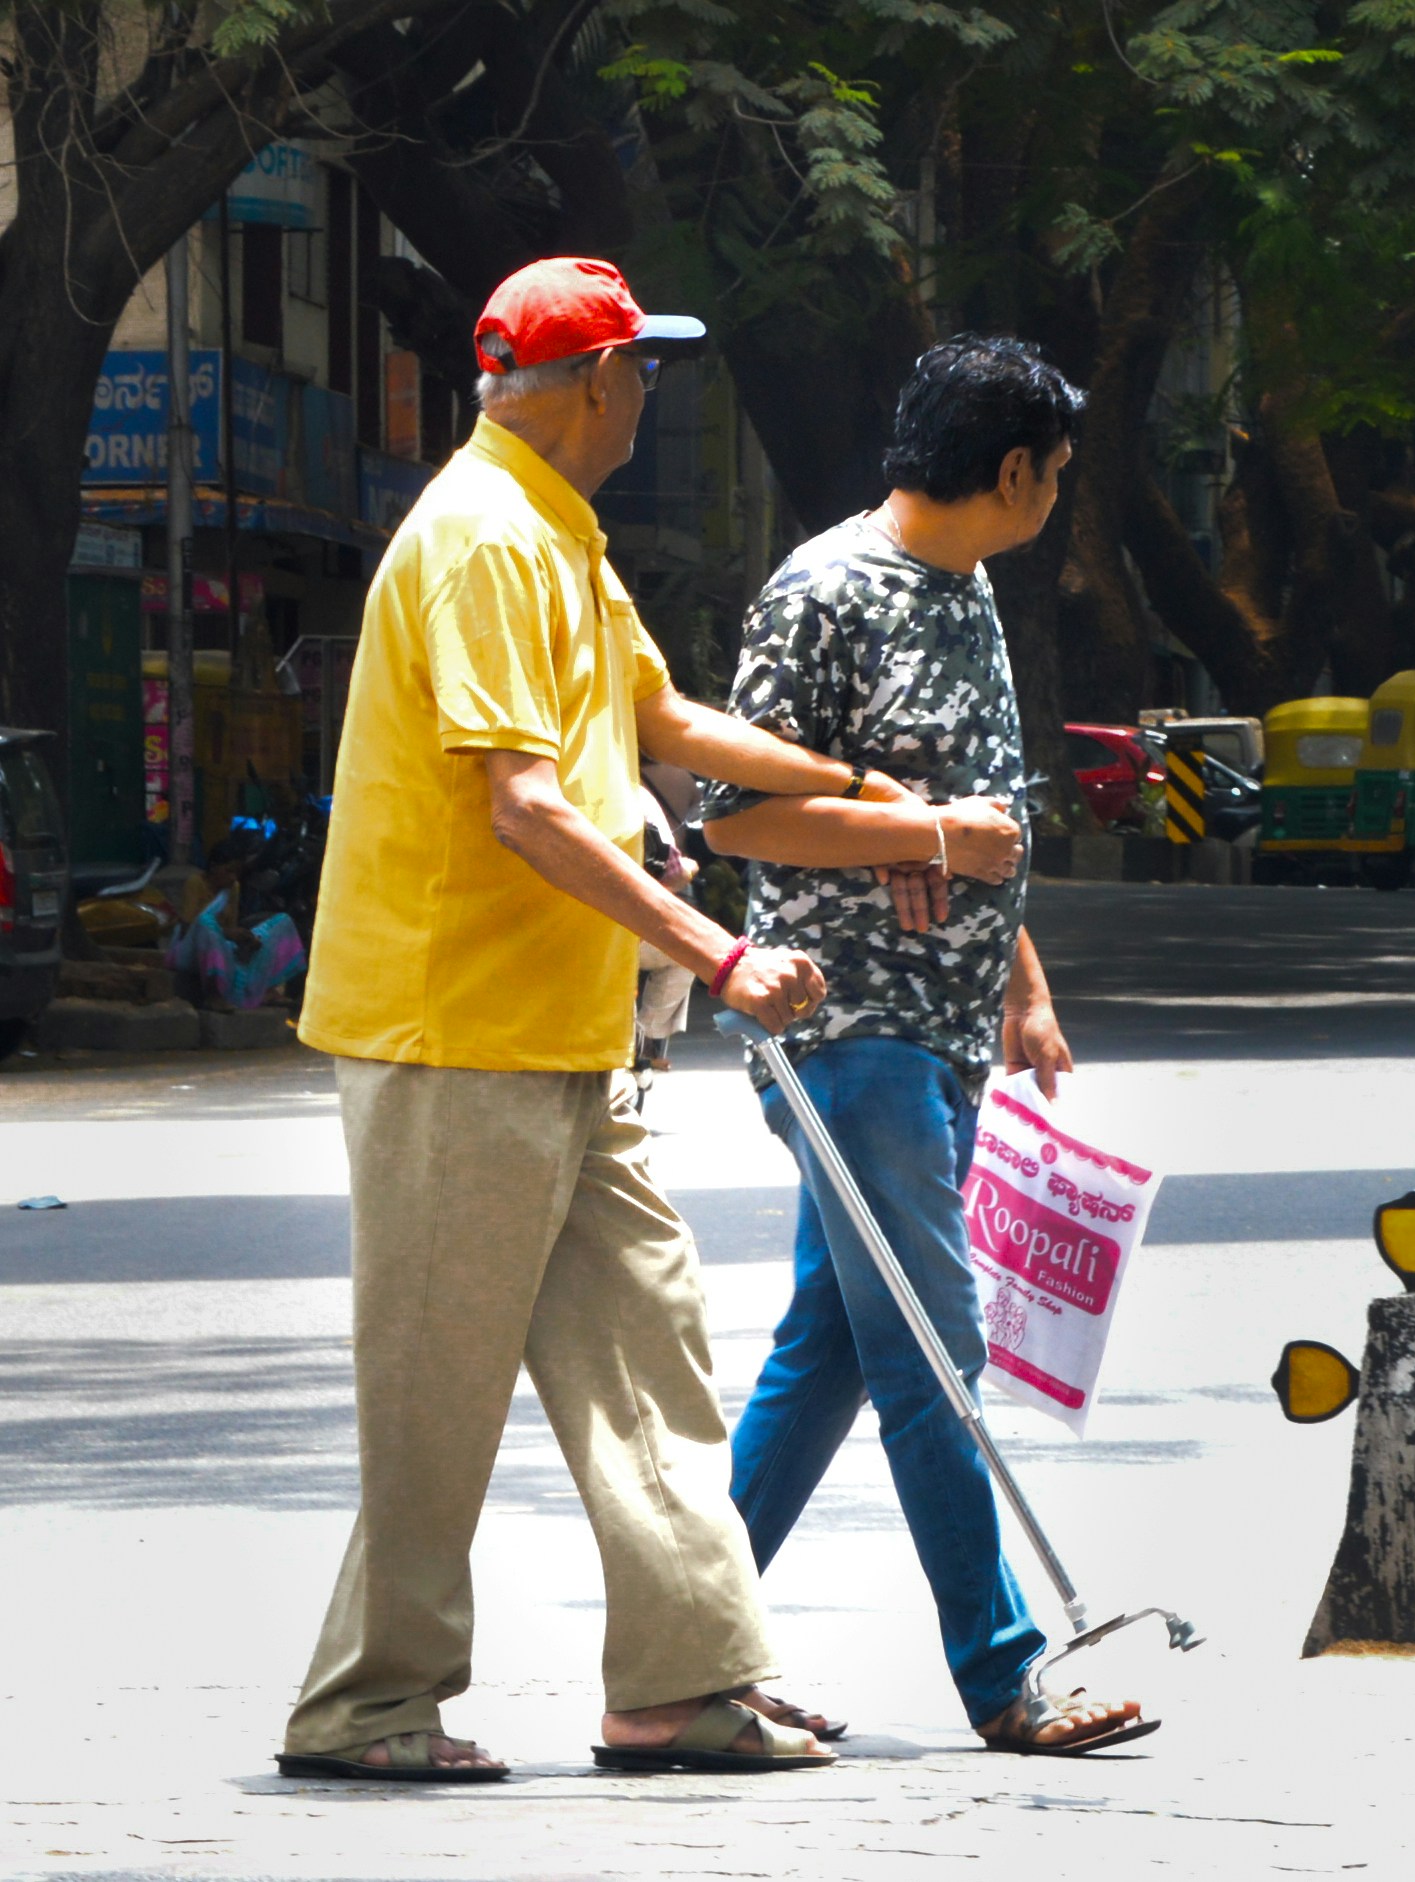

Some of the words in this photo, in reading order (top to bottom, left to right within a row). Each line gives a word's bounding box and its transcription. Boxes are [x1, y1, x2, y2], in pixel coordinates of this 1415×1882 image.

[964, 1177, 1101, 1283] Roopali
[1036, 1295, 1063, 1316] Shop
[1037, 1270, 1096, 1307] Fashion
